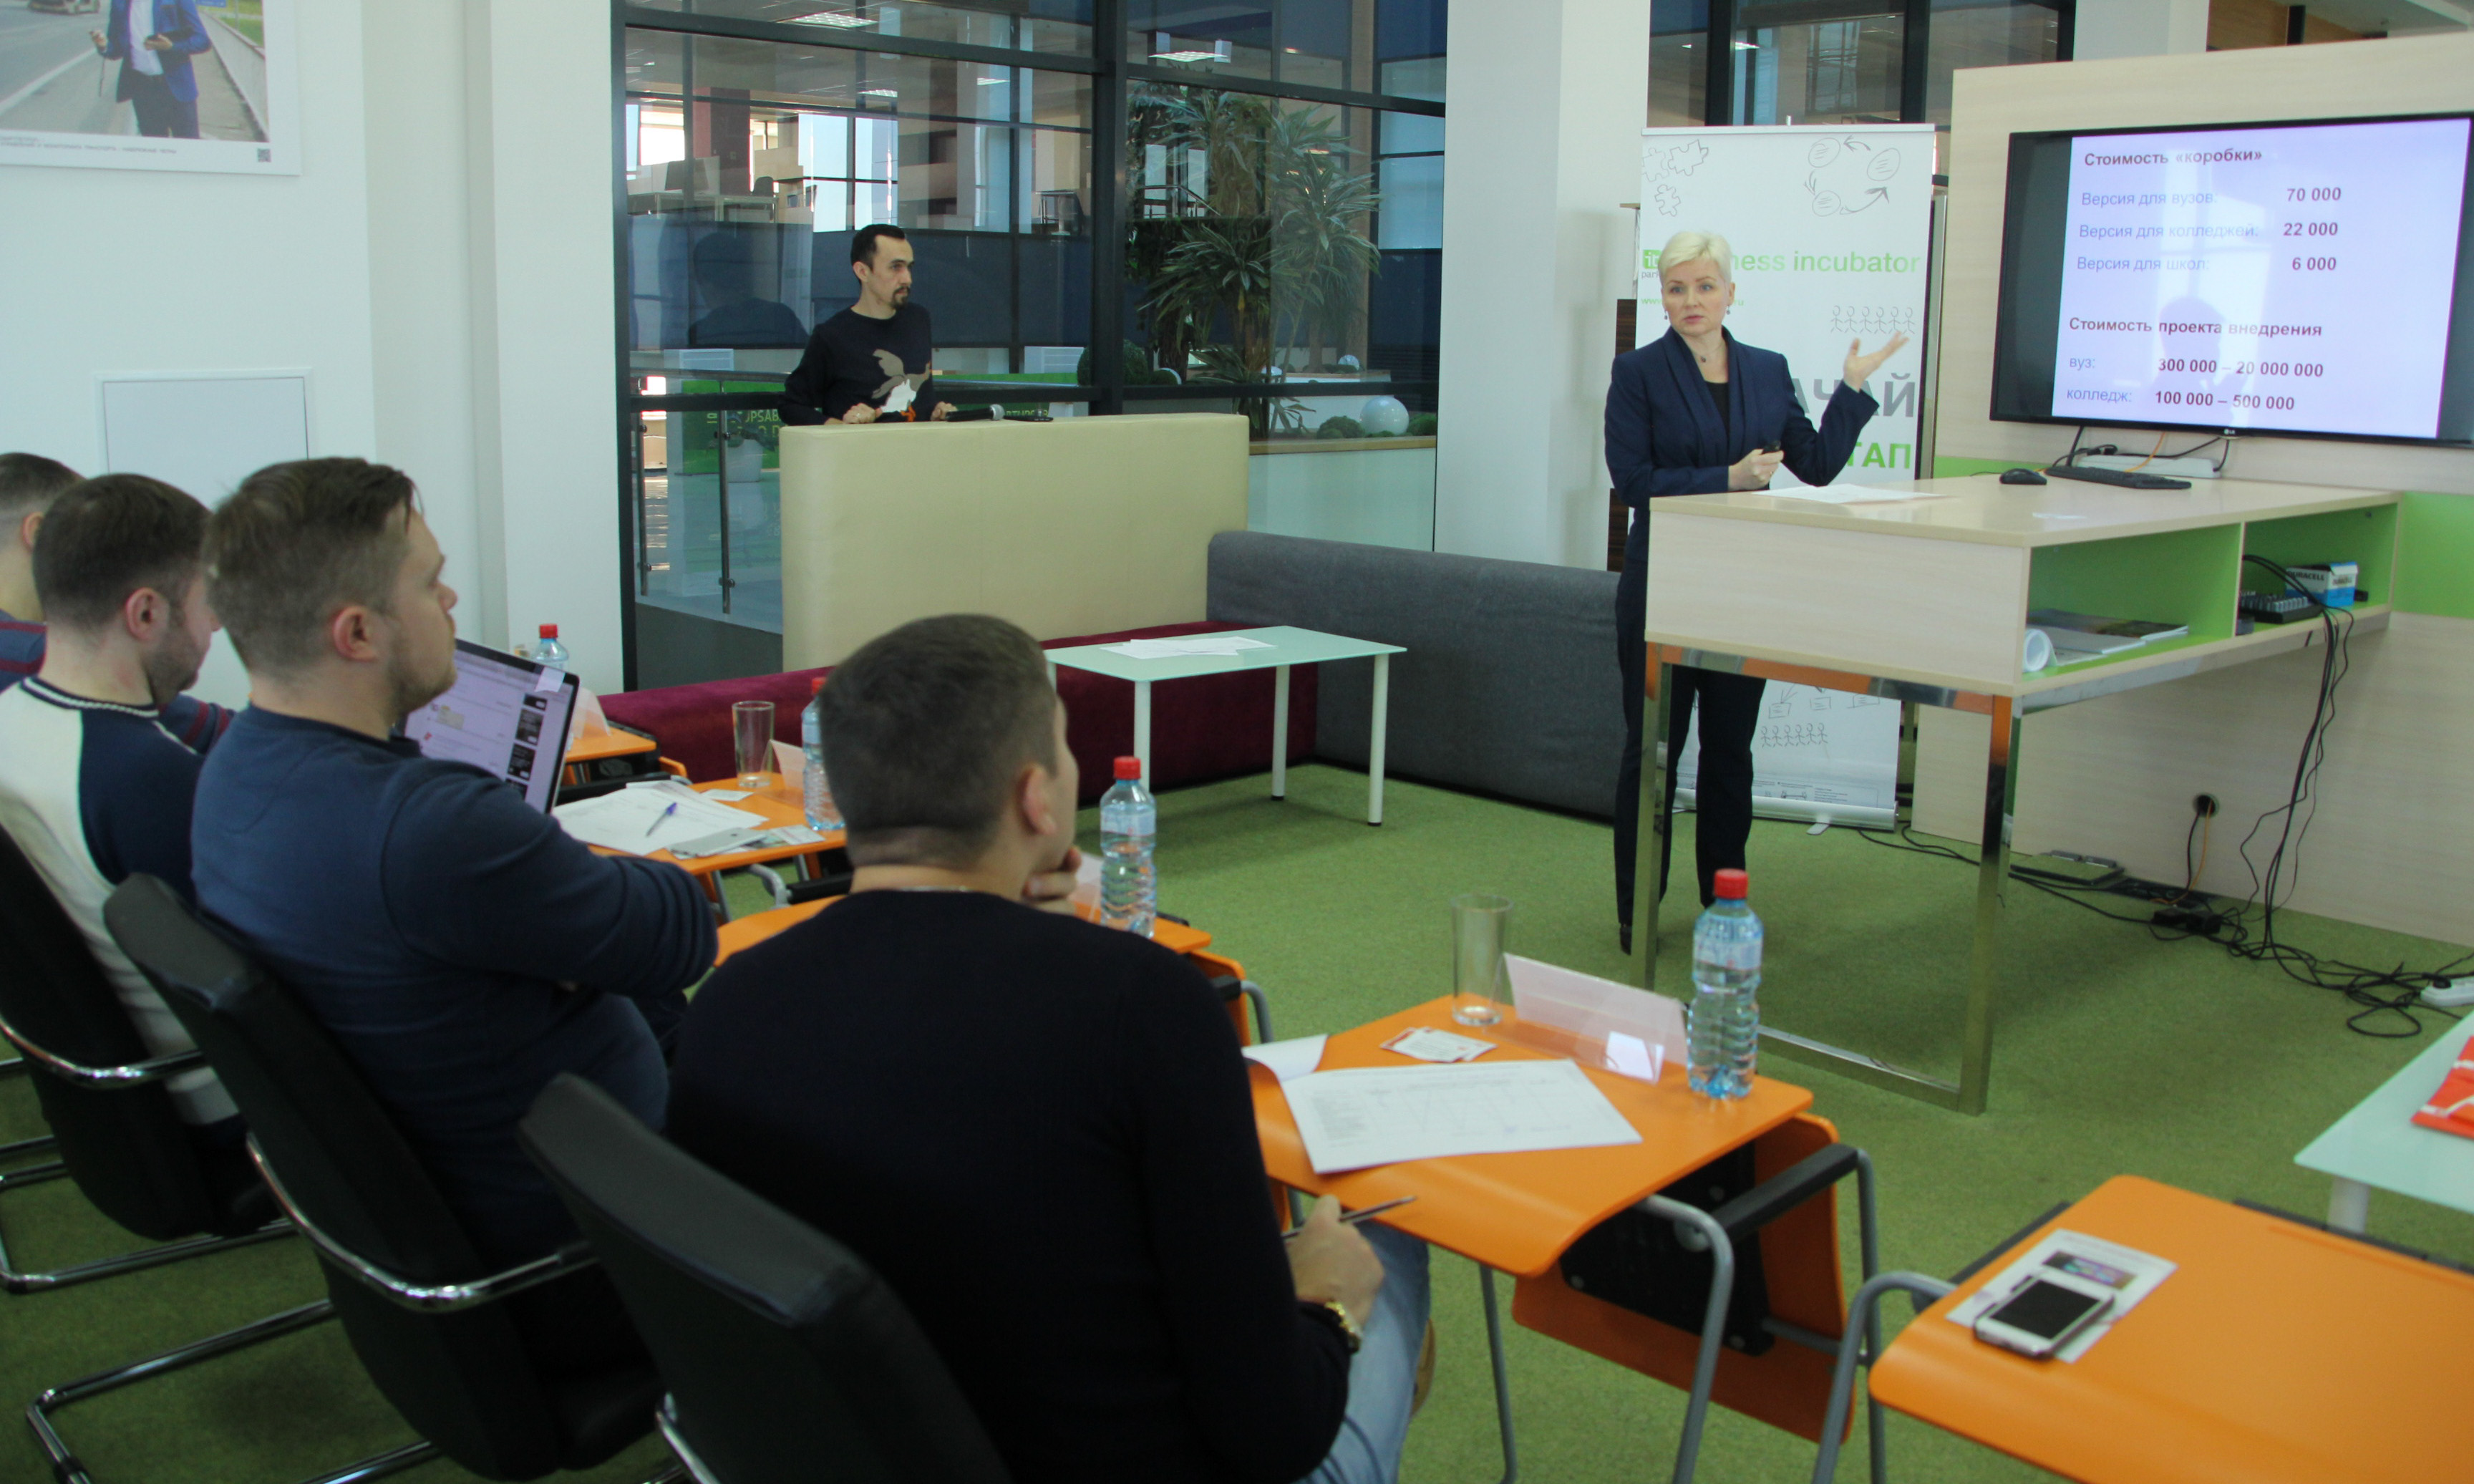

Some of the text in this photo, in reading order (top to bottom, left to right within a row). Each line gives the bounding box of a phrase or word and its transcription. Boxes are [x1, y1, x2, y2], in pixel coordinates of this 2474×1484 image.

[2084, 148, 2262, 166] Стоимость «коробки»
[2081, 187, 2342, 208] Версия для вузов: 70 000
[2079, 222, 2338, 241] Версия для колледжей: 22 000
[1793, 251, 1921, 273] incubator
[2077, 256, 2337, 272] Версия для школ: 6 000
[2069, 317, 2322, 338] Стоимость проекта внедрения
[2069, 357, 2095, 371] вуз:
[2158, 359, 2185, 372] 300
[2190, 359, 2217, 373] 000
[2236, 361, 2255, 374] 20
[2260, 362, 2289, 376] 000
[2294, 363, 2324, 377] 000
[2067, 389, 2132, 403] колледж:
[2155, 391, 2181, 404] 100
[2186, 392, 2213, 406] 000
[2233, 394, 2261, 409] 500
[2266, 396, 2294, 410] 000
